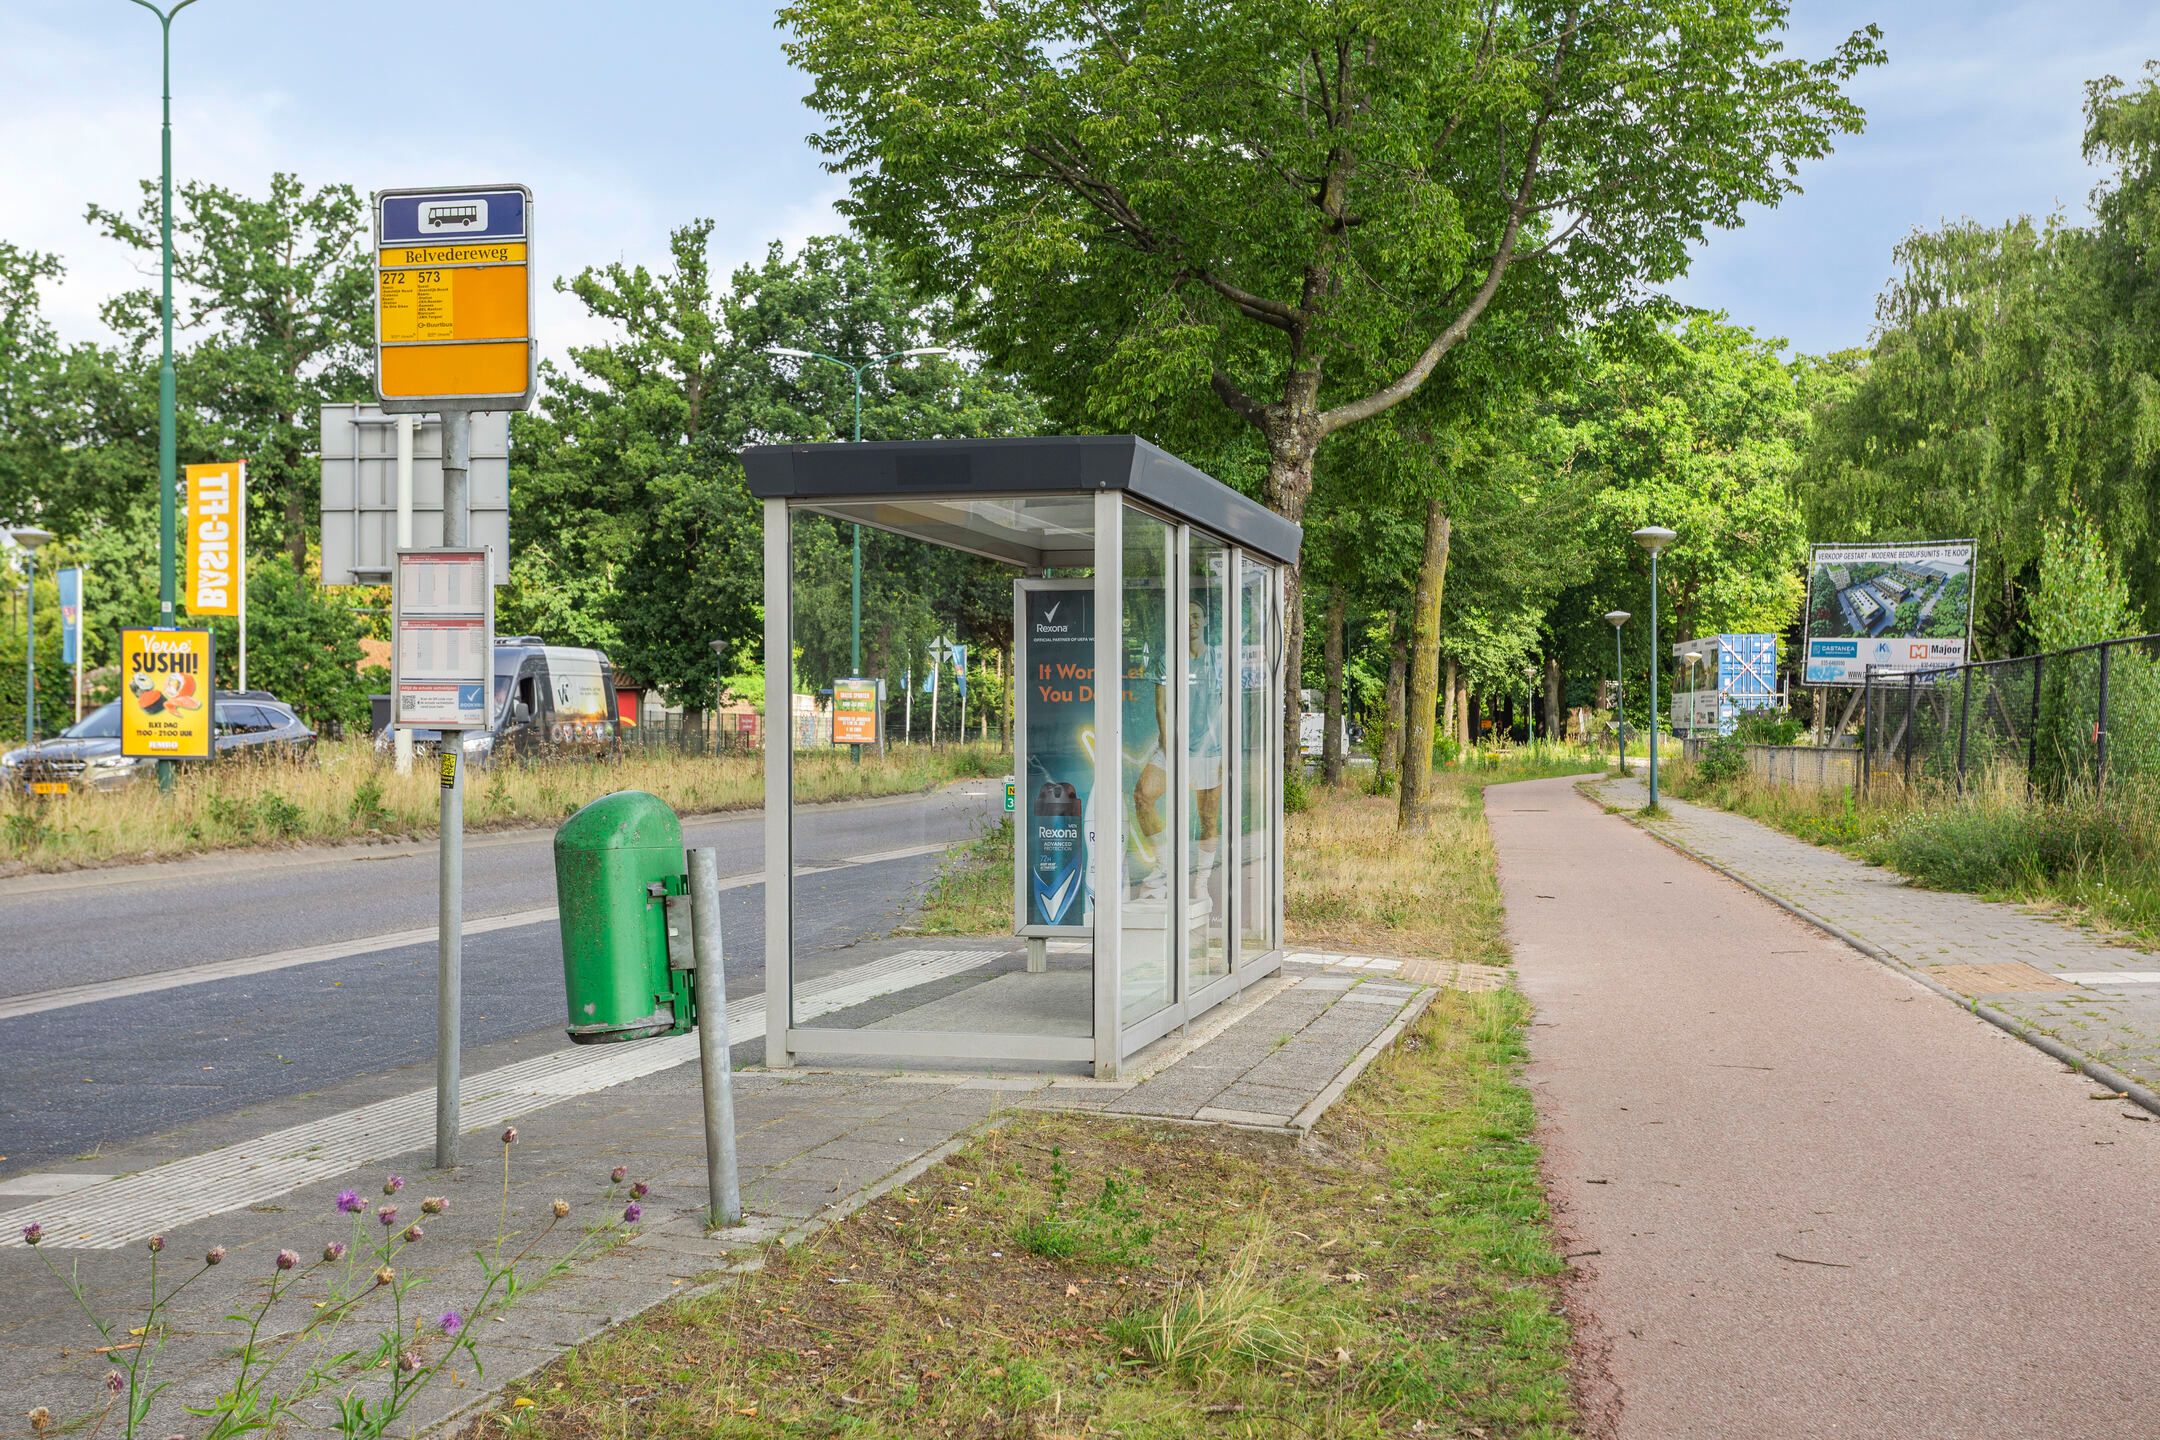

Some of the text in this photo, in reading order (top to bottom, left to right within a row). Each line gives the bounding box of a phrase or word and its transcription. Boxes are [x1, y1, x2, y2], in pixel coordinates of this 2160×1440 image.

[405, 247, 508, 263] Belvedereweg
[382, 273, 404, 284] 272
[418, 271, 440, 283] 573
[1036, 624, 1068, 632] Rexona
[140, 634, 191, 653] Verse
[1931, 645, 1961, 655] Majoor
[132, 652, 198, 674] SUSHI!
[1039, 664, 1052, 680] It
[1039, 686, 1072, 702] You
[1039, 826, 1077, 838] Rexona
